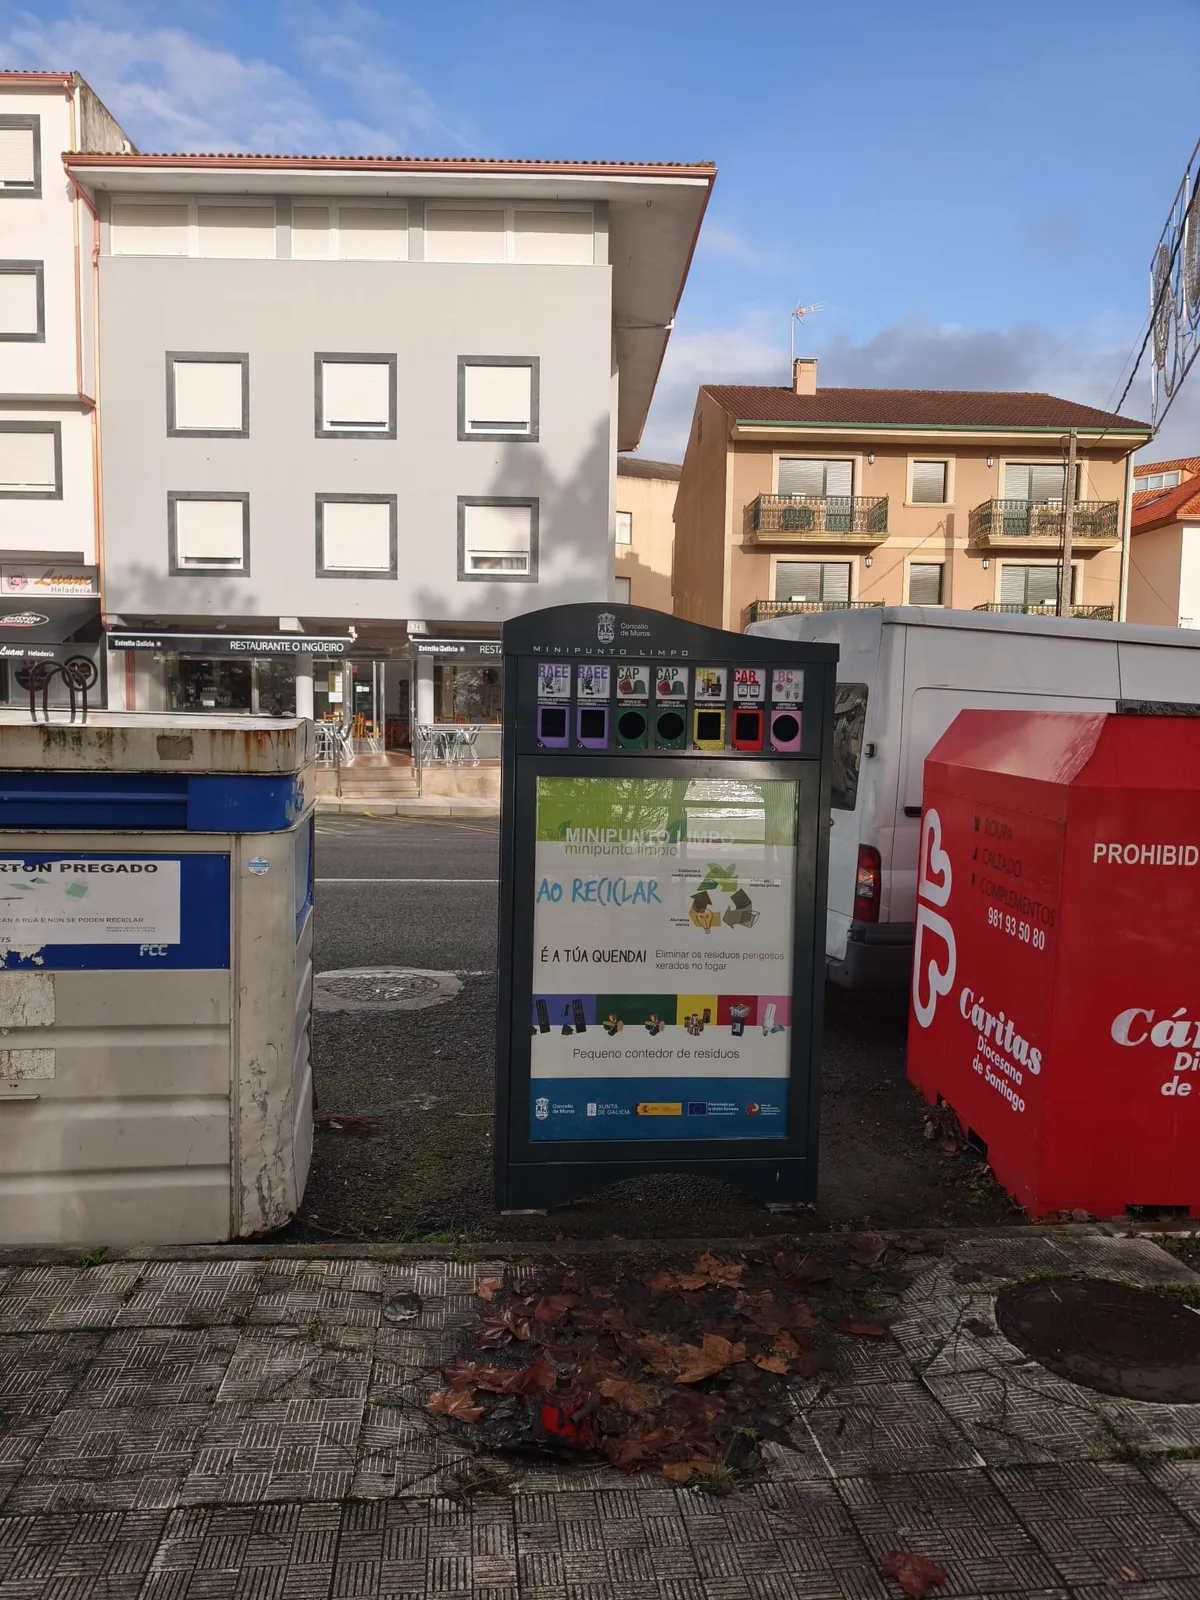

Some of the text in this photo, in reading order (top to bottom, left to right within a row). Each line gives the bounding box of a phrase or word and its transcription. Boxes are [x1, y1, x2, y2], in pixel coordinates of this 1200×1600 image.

[620, 622, 649, 630] Concello
[620, 629, 629, 637] de
[230, 641, 344, 652] RESTAURANTE O INGÜEIRO
[533, 645, 689, 657] MINIPUNTO LIMPO
[538, 665, 569, 678] RAEE
[577, 666, 608, 680] RAEE
[617, 667, 640, 680] CAP
[656, 668, 679, 681] CAP
[565, 827, 670, 844] MINIPUNTO
[984, 818, 1013, 841] ROUPA
[565, 844, 633, 857] minipunto
[60, 863, 158, 874] PREGADO
[982, 848, 1022, 878] CALZADO
[537, 877, 662, 906] AO RECICLAR
[980, 878, 1056, 928] COMPLEMENTOS
[988, 906, 1045, 950] 981 93 50 80
[140, 944, 168, 957] FCC
[540, 946, 647, 964] É A TÚA QUENDA!
[655, 949, 785, 962] Eliminar os residuos perigosos
[655, 961, 728, 972] xerados no fogar
[960, 987, 1042, 1075] Cáritas
[572, 1048, 740, 1061] Pequeno contedor de residuos
[977, 1034, 1023, 1086] Diocesana
[972, 1054, 1025, 1113] de Santiago
[1161, 1075, 1192, 1096] de
